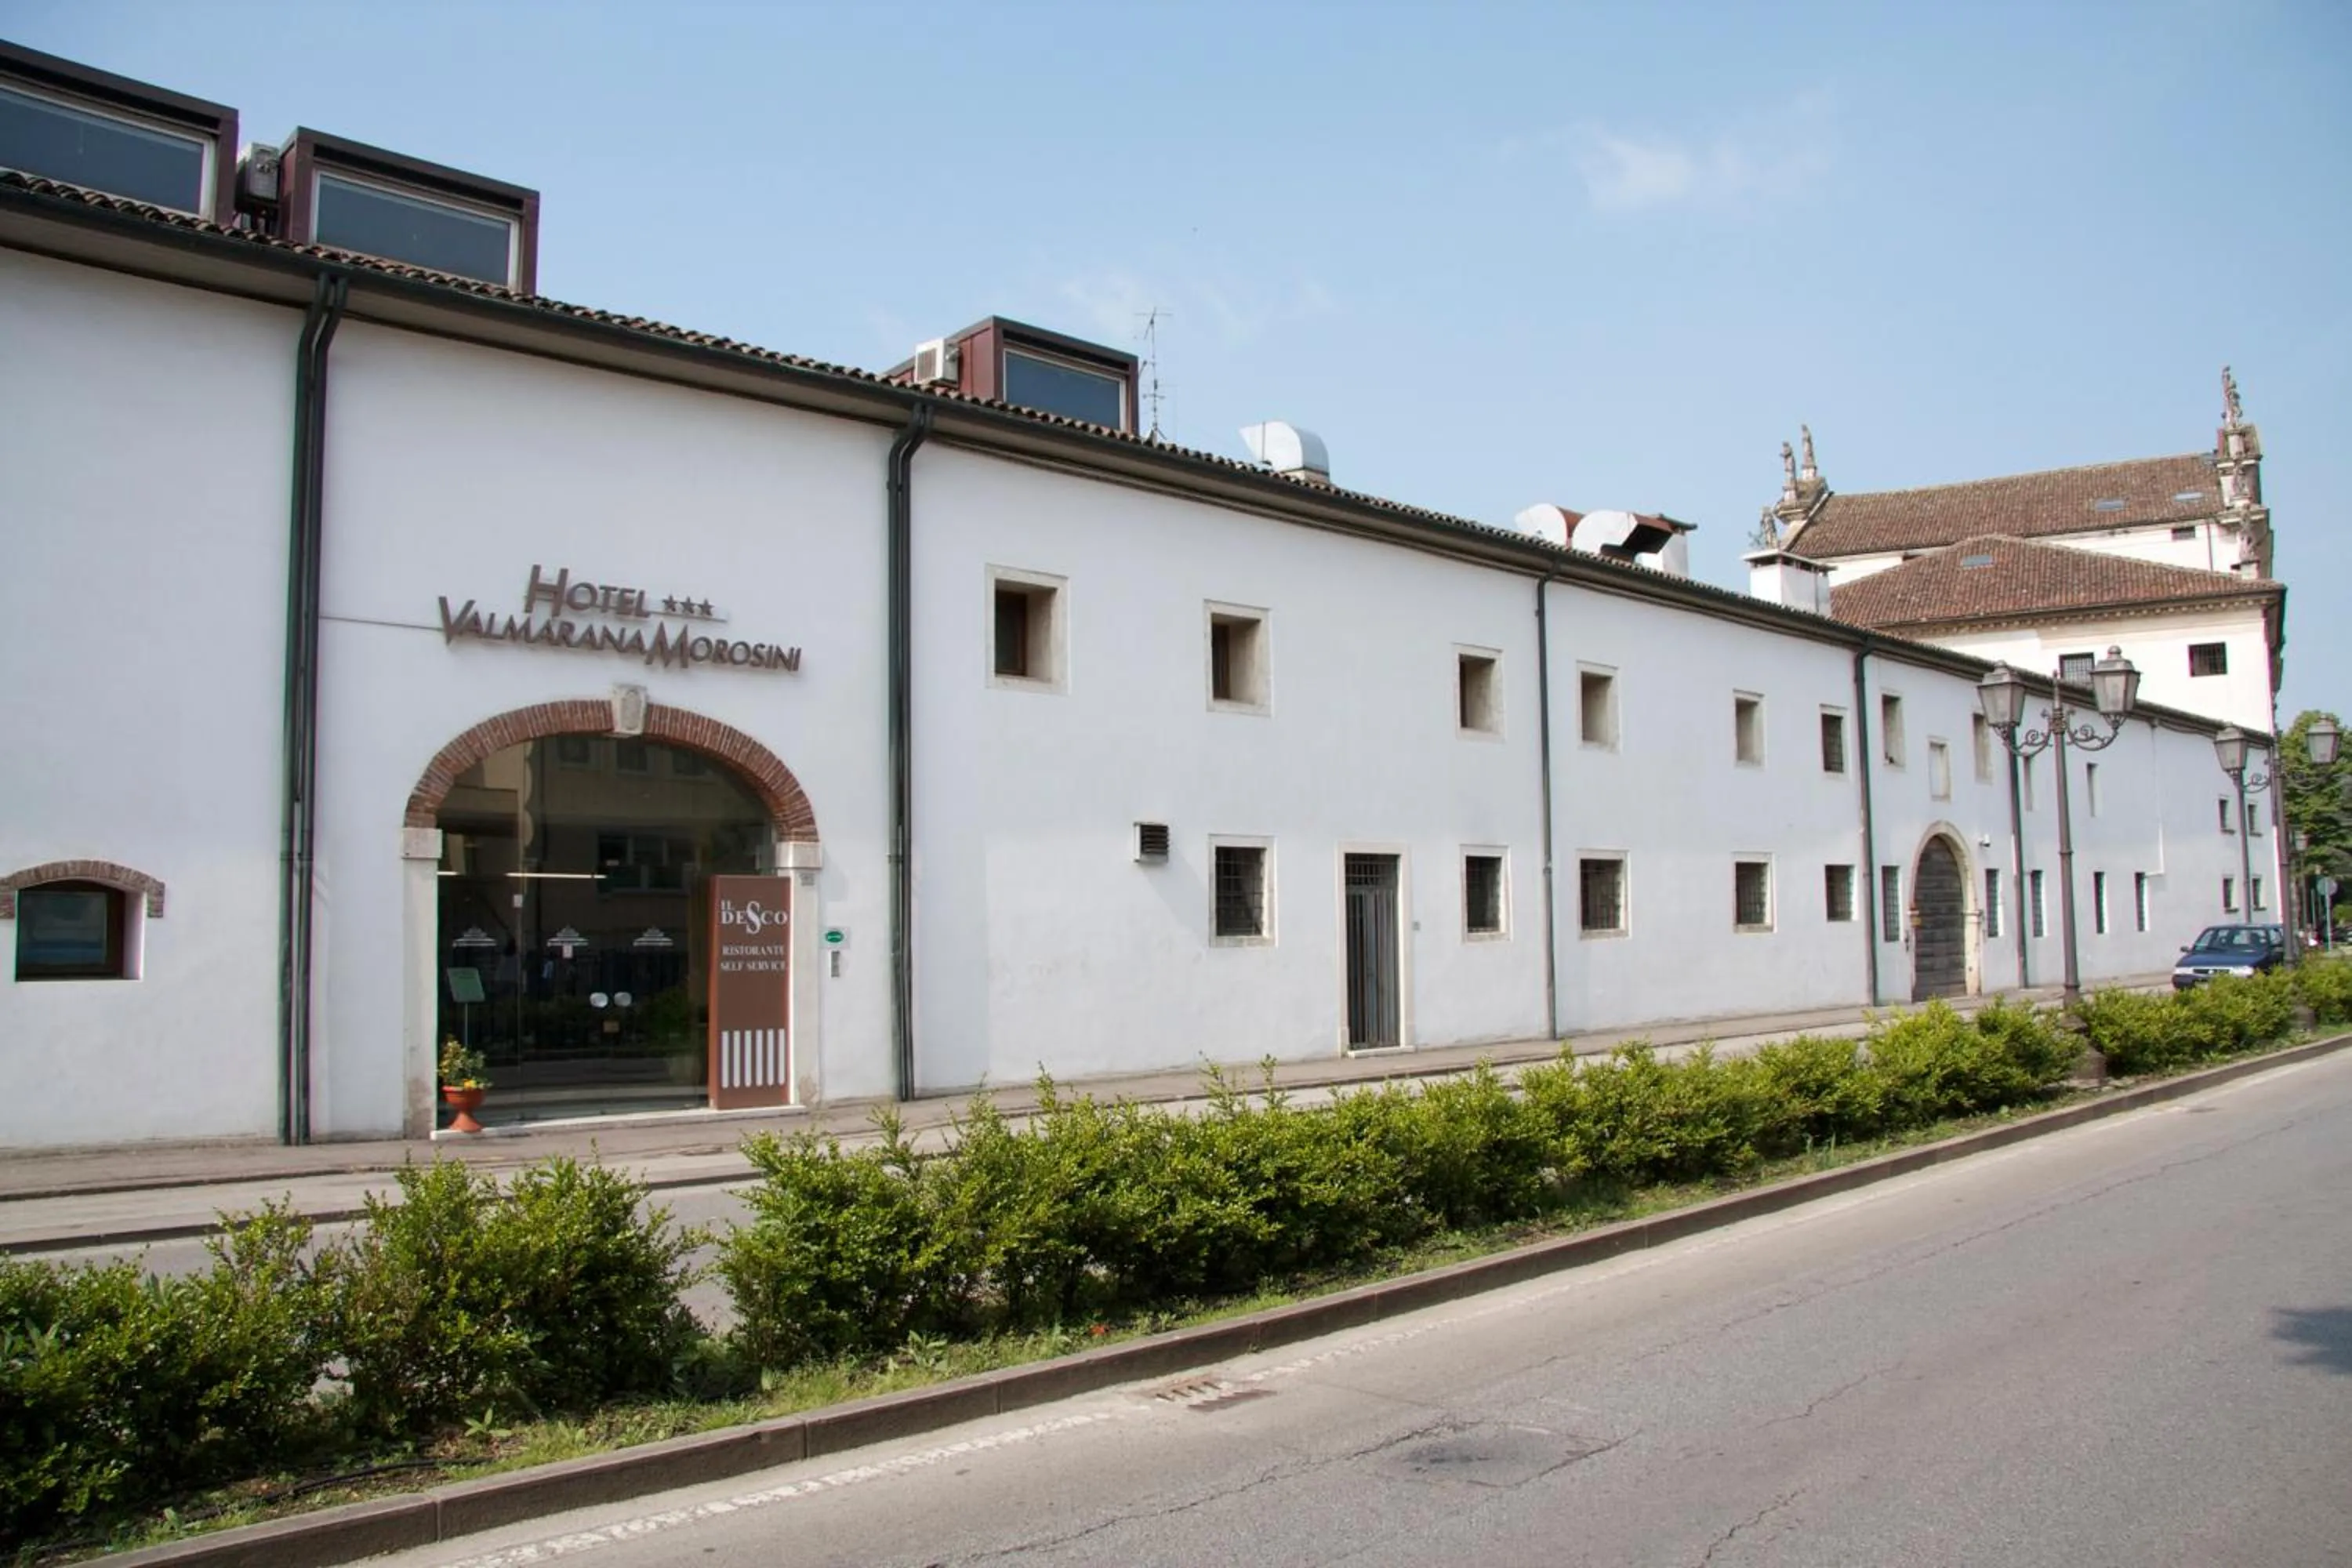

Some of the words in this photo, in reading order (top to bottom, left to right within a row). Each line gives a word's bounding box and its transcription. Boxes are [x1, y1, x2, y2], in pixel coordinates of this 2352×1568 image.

[524, 564, 650, 618] HOTEL
[720, 899, 735, 910] IL
[721, 900, 788, 935] DESCO
[722, 945, 784, 956] RISTORANTE
[720, 960, 744, 971] SELF
[746, 959, 786, 971] SERVICE
